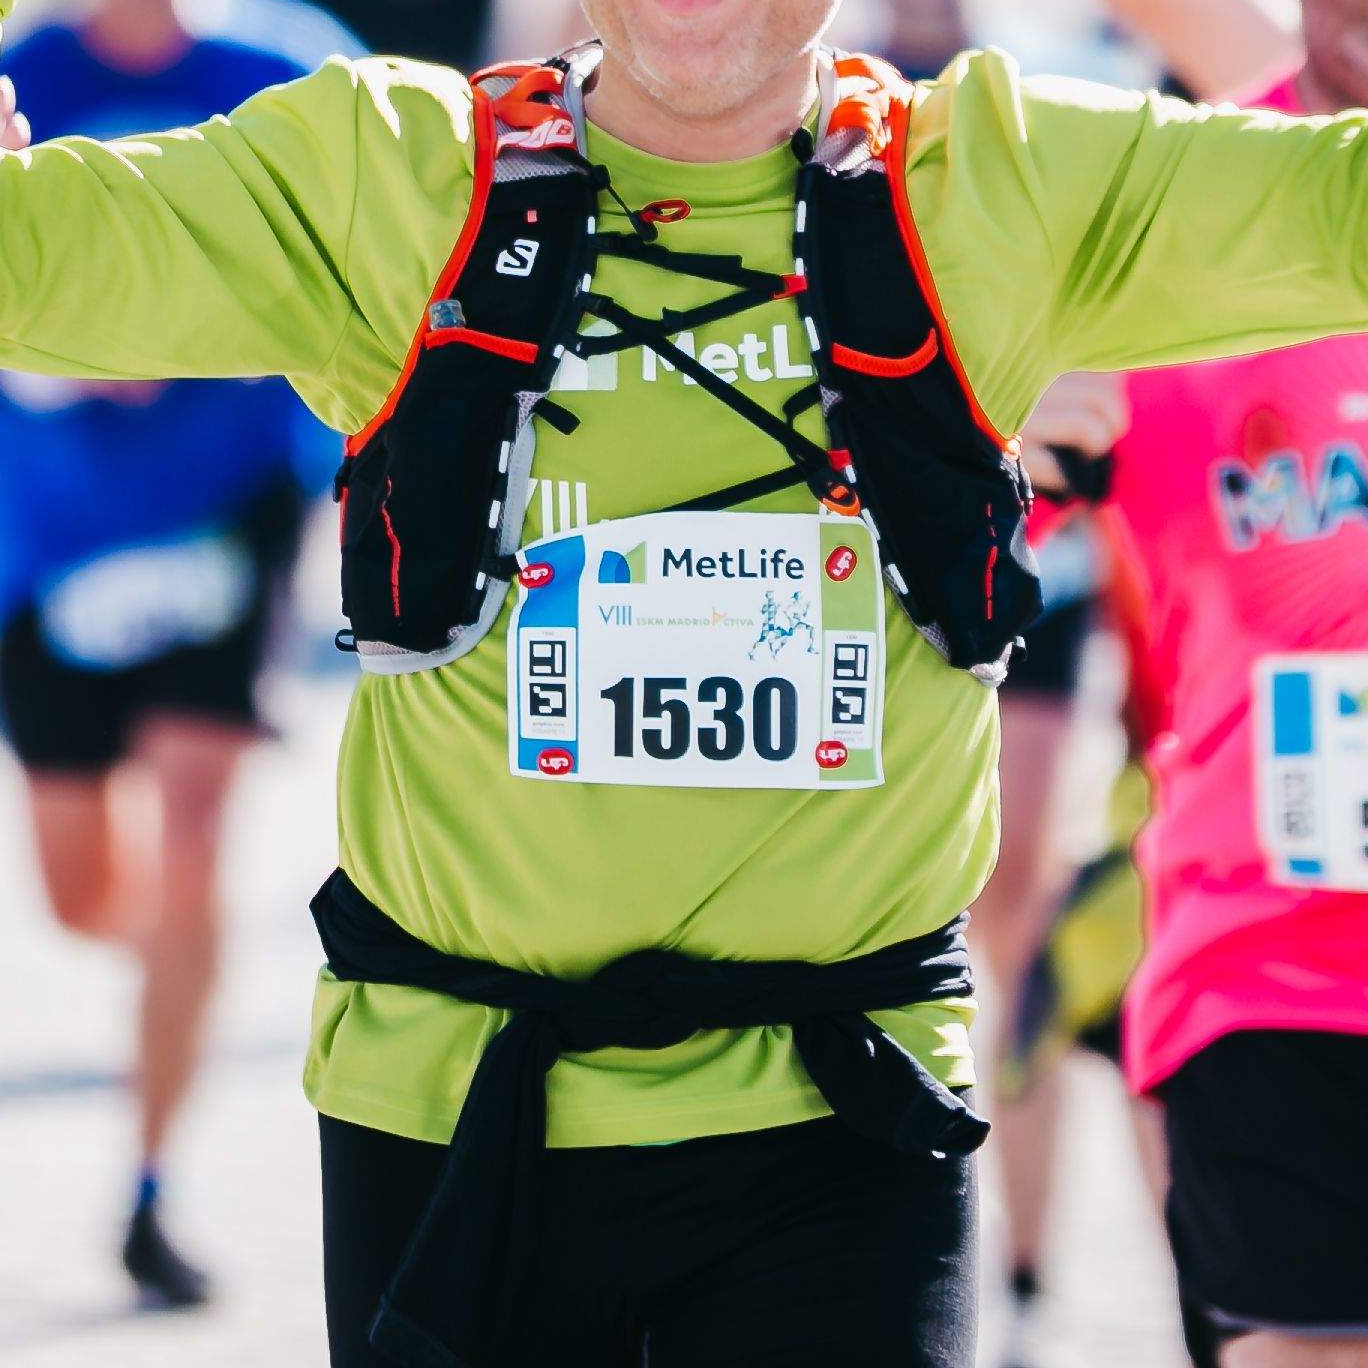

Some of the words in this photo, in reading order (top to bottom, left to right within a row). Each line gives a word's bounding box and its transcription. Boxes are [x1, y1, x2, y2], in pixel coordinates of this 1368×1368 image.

[641, 324, 813, 385] MetL
[662, 548, 805, 580] MetLife
[598, 605, 632, 626] VIII
[668, 617, 711, 627] MADRID
[600, 676, 797, 761] 1530
